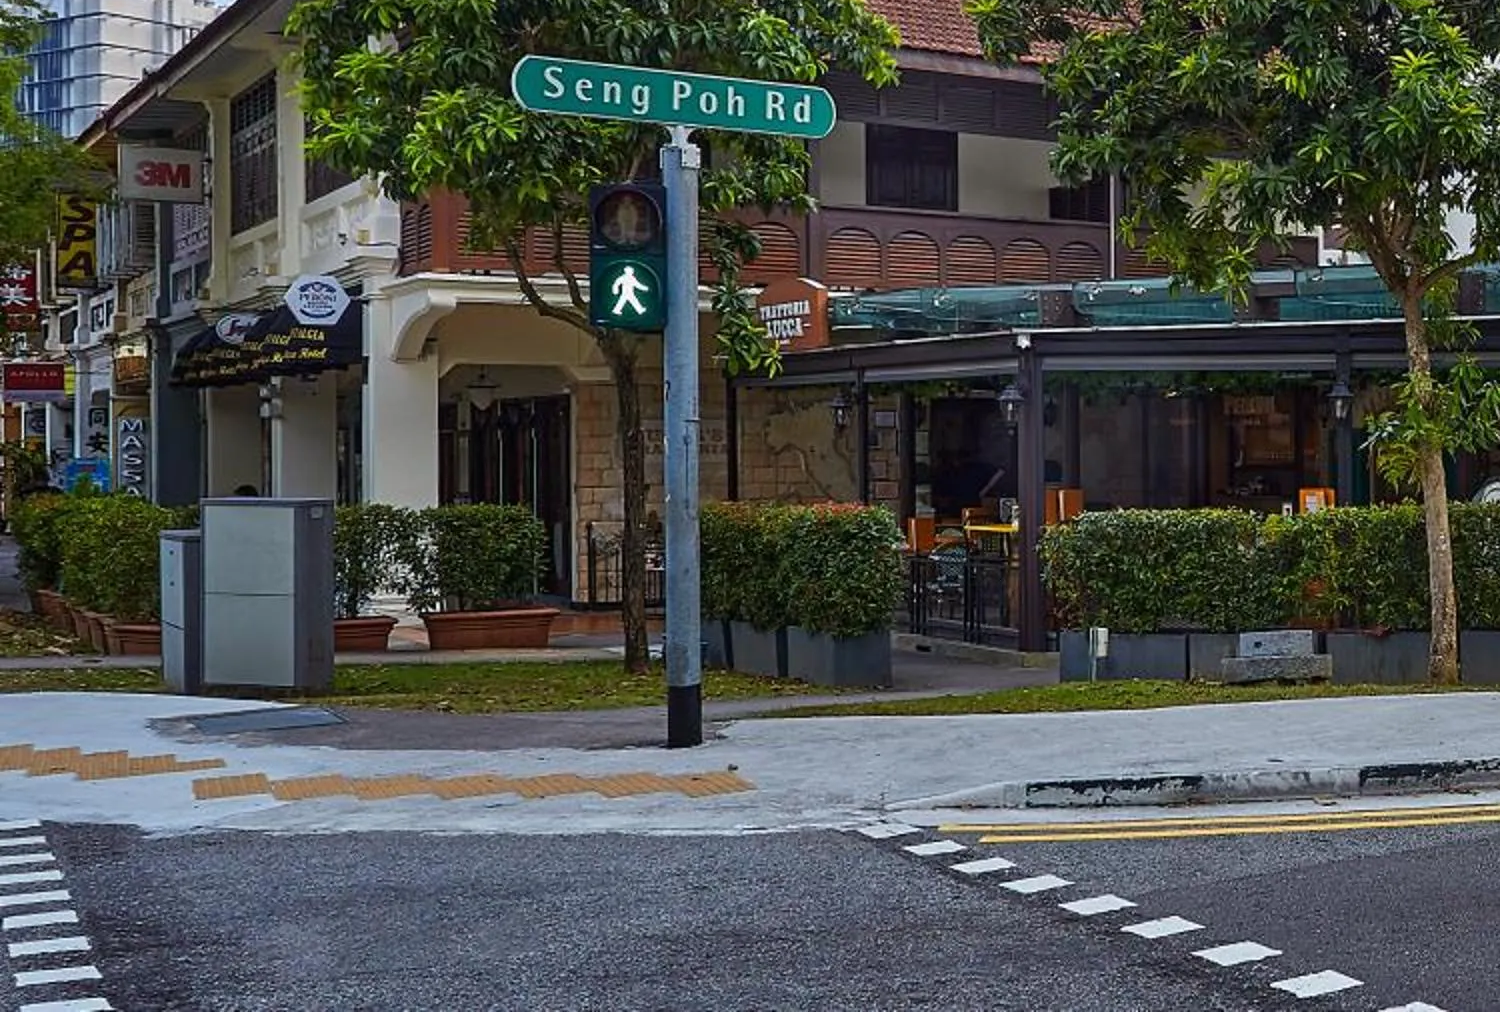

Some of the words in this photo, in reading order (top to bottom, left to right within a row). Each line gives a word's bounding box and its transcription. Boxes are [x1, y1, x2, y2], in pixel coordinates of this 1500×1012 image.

[543, 66, 650, 115] Seng
[671, 79, 745, 118] Poh
[765, 90, 811, 124] Rd
[135, 159, 191, 188] 3M
[59, 192, 96, 277] SPA
[760, 300, 811, 320] TRATTORIA
[766, 318, 804, 338] LUCCA
